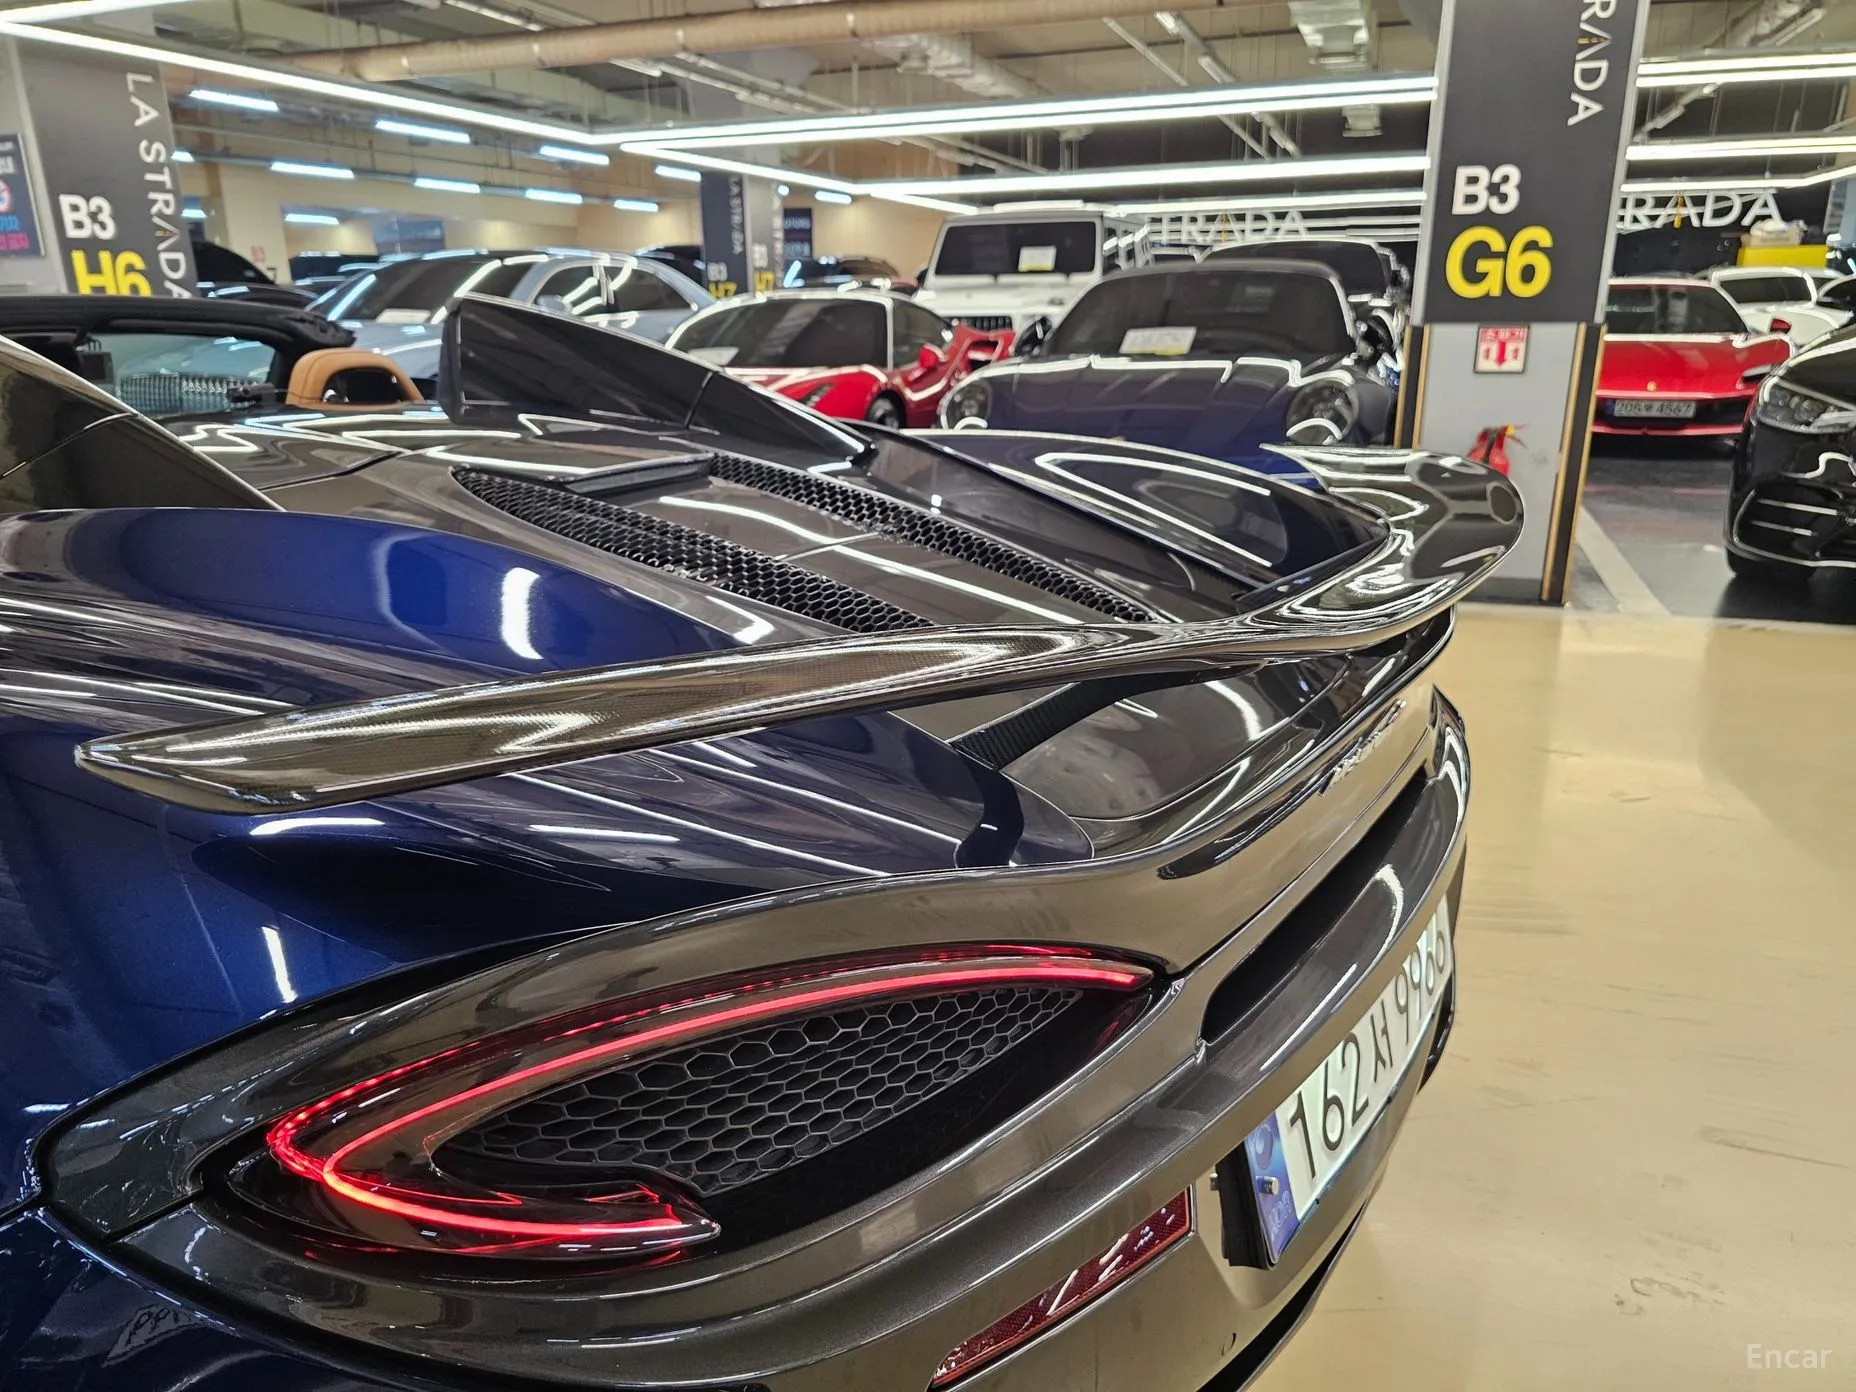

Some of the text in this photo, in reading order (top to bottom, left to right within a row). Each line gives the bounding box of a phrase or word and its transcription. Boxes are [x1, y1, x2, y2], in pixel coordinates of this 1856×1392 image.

[126, 72, 160, 127] LA
[1452, 164, 1522, 215] B3
[59, 194, 116, 240] B3
[71, 250, 152, 297] H6
[1445, 226, 1553, 299] G6
